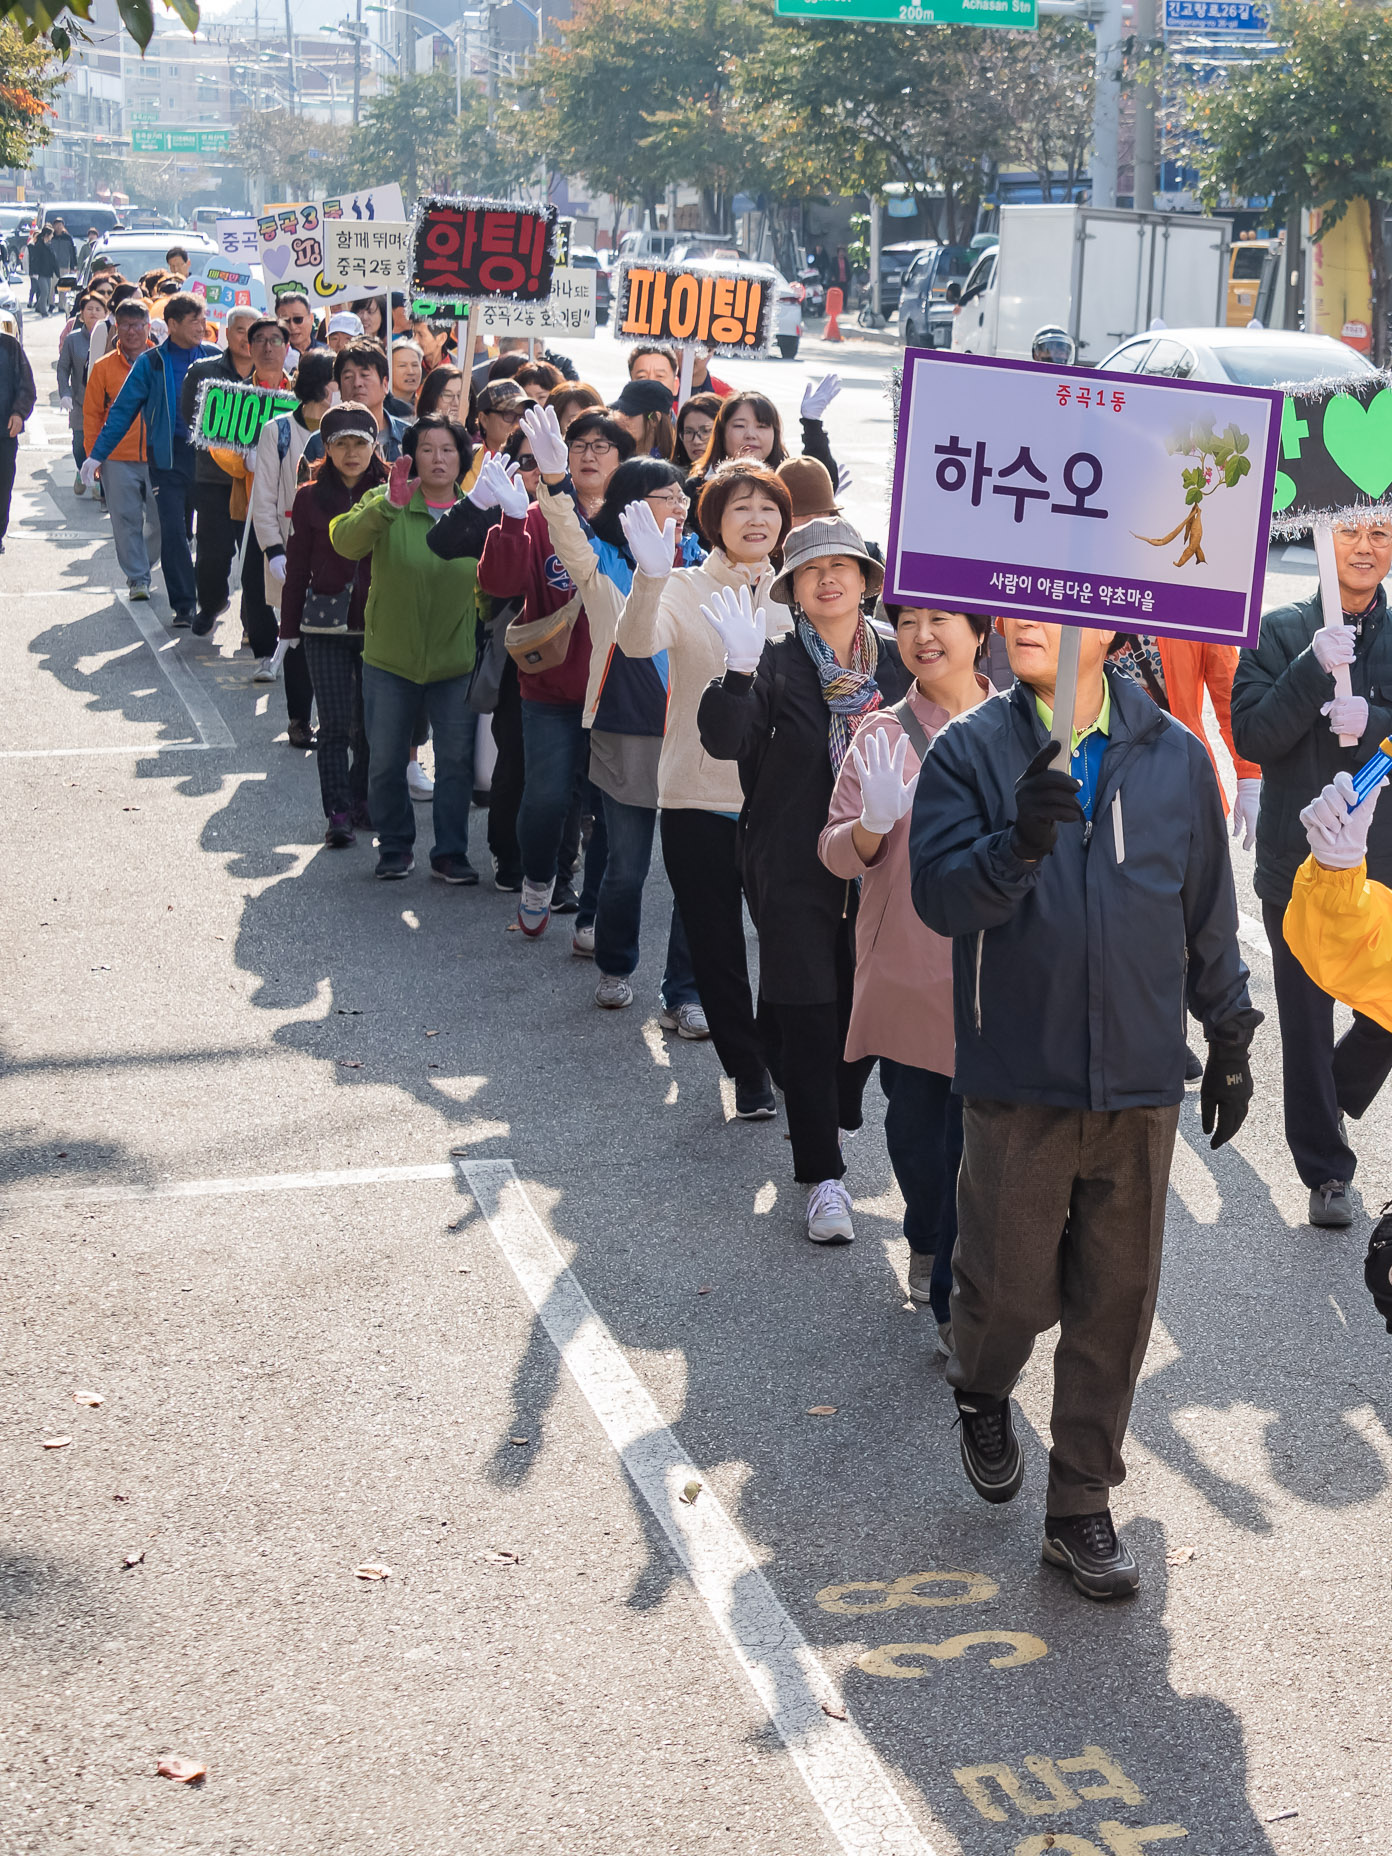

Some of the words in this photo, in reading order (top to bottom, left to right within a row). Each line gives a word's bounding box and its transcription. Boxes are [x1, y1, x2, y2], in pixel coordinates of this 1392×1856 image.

[899, 6, 935, 21] 200m
[1011, 1, 1031, 13] Stn
[336, 230, 369, 249] 함께
[422, 208, 546, 292] 홧팅!
[336, 257, 392, 279] 중곡2동
[483, 305, 535, 327] 중곡2동
[622, 268, 762, 345] 파이팅!
[1055, 384, 1126, 413] 중곡1동
[933, 434, 1109, 524] 하수오
[989, 572, 1032, 595] 사람이
[1037, 577, 1094, 605] 아름다운
[1098, 585, 1156, 612] 약초마을
[814, 1570, 1048, 1679] 38
